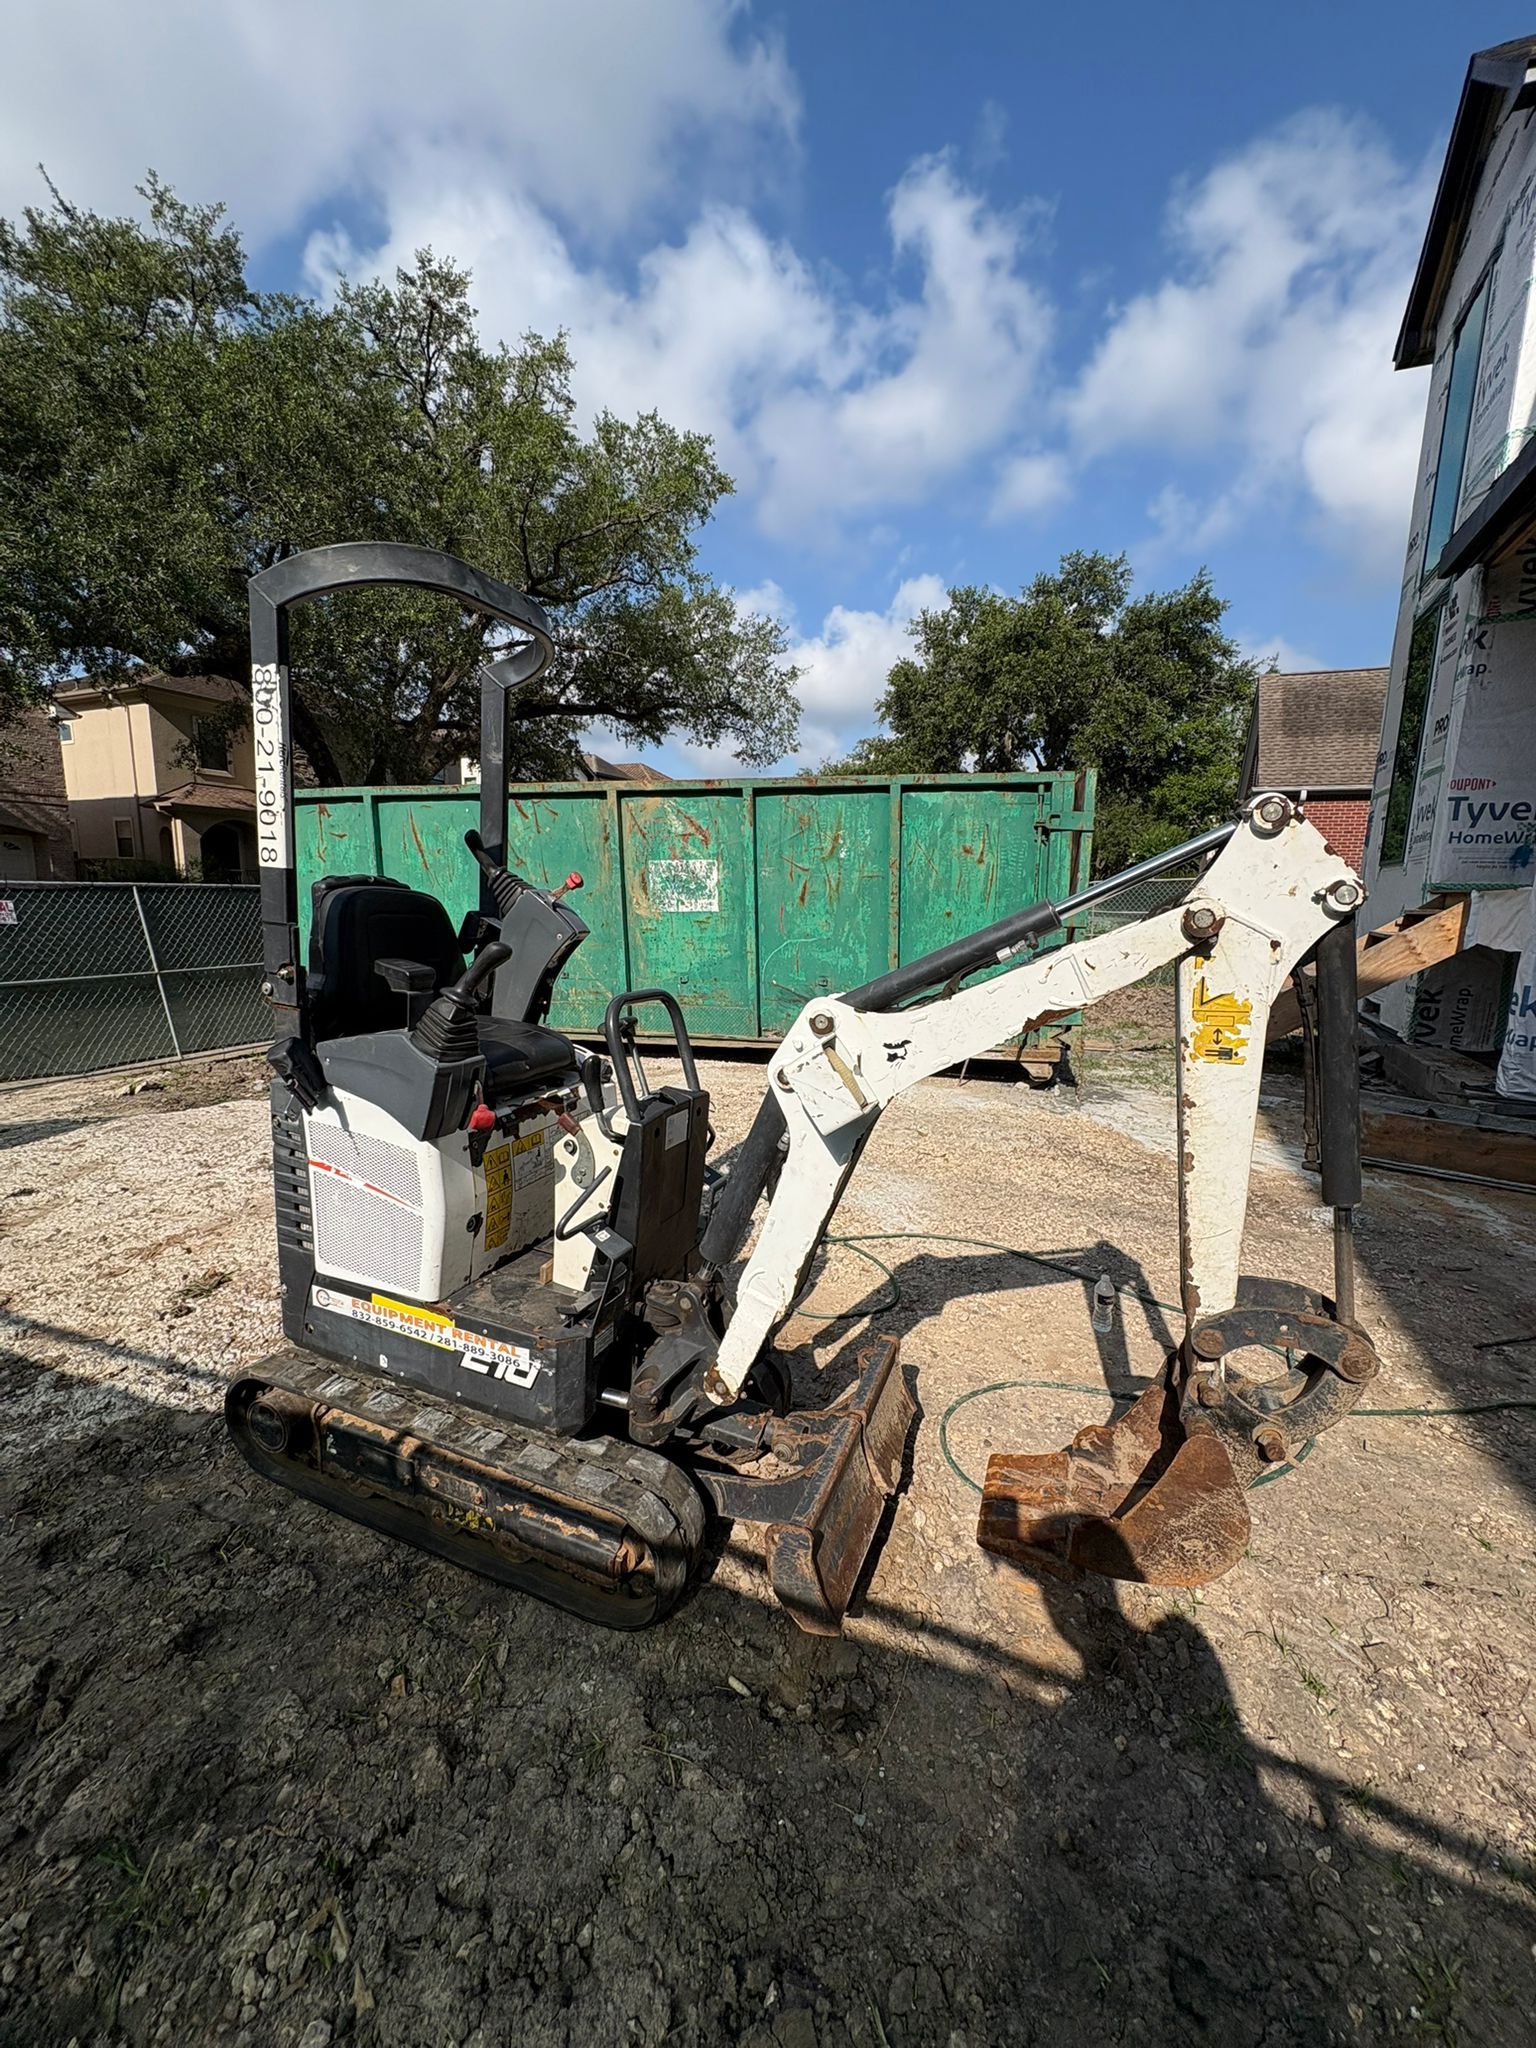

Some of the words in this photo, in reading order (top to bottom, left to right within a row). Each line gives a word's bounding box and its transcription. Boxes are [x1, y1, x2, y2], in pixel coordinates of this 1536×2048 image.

[1449, 778, 1492, 791] DUPONT
[1447, 796, 1536, 829] Tyve
[1448, 831, 1536, 845] HomeWr
[351, 1298, 447, 1335] EQUIPMENT
[452, 1328, 521, 1358] RENTAL
[351, 1309, 428, 1340] 832-859-6542
[437, 1335, 521, 1368] 281-889-3086
